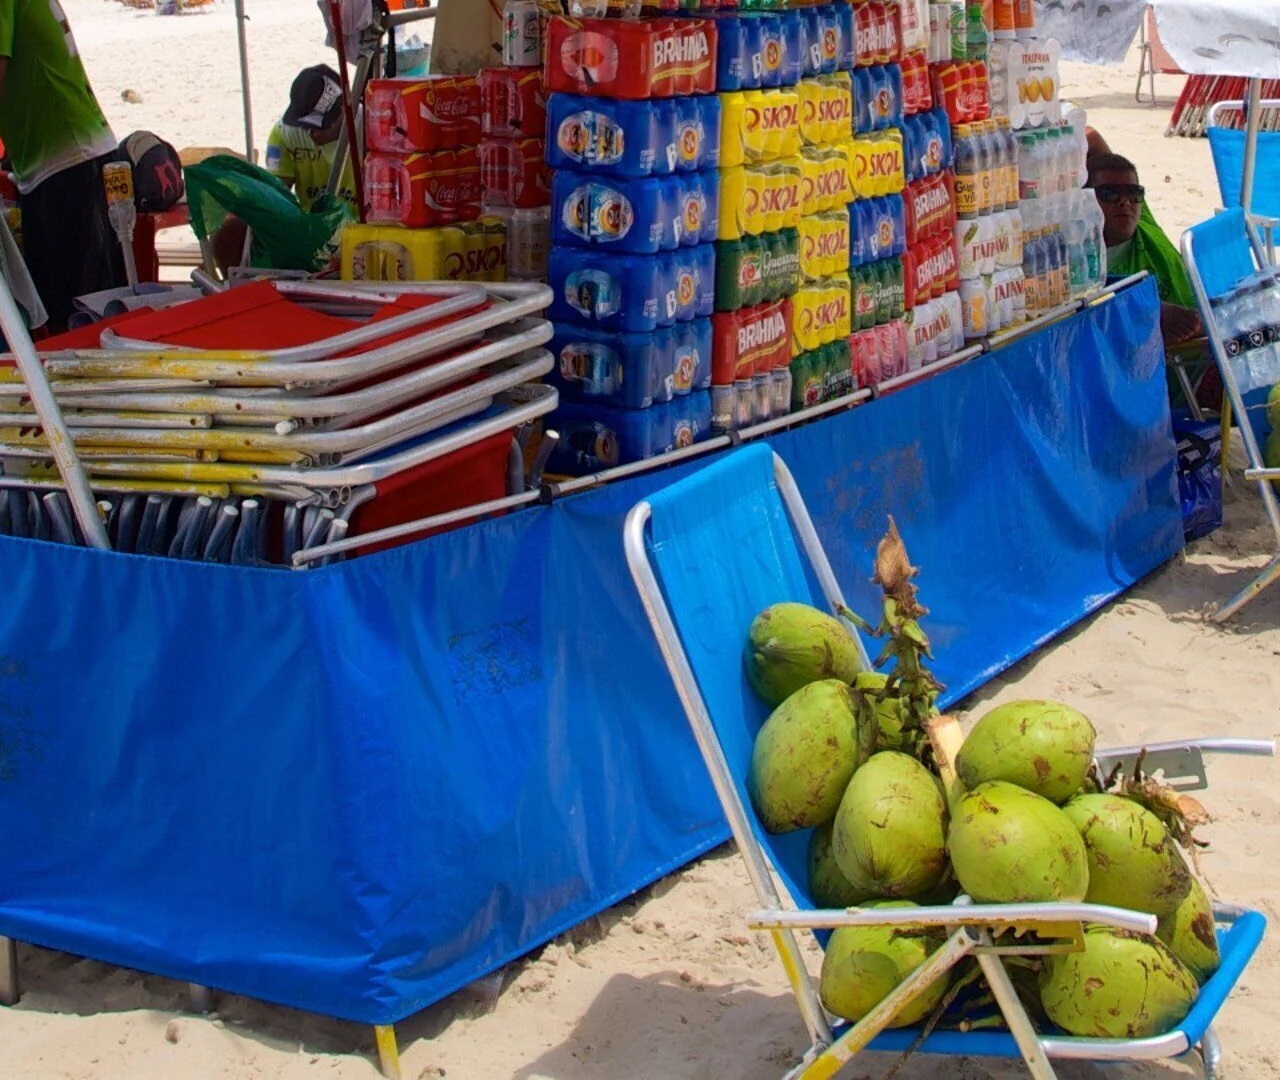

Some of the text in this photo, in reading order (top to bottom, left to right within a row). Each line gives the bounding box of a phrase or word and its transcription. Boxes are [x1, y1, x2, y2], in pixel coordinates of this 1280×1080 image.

[653, 31, 709, 68] BRAHMA
[855, 20, 897, 54] BRAHMA
[761, 102, 799, 130] SKOL
[818, 97, 850, 121] SKOL
[869, 150, 902, 177] SKOL
[817, 168, 848, 195] SKOL
[760, 184, 799, 215] SKOL
[914, 182, 950, 220] BRAHMA
[466, 243, 507, 274] SKOL
[816, 228, 847, 258] SKOL
[917, 246, 955, 289] BRAHMA
[814, 299, 847, 331] SKOL
[738, 312, 786, 355] BRAHMA
